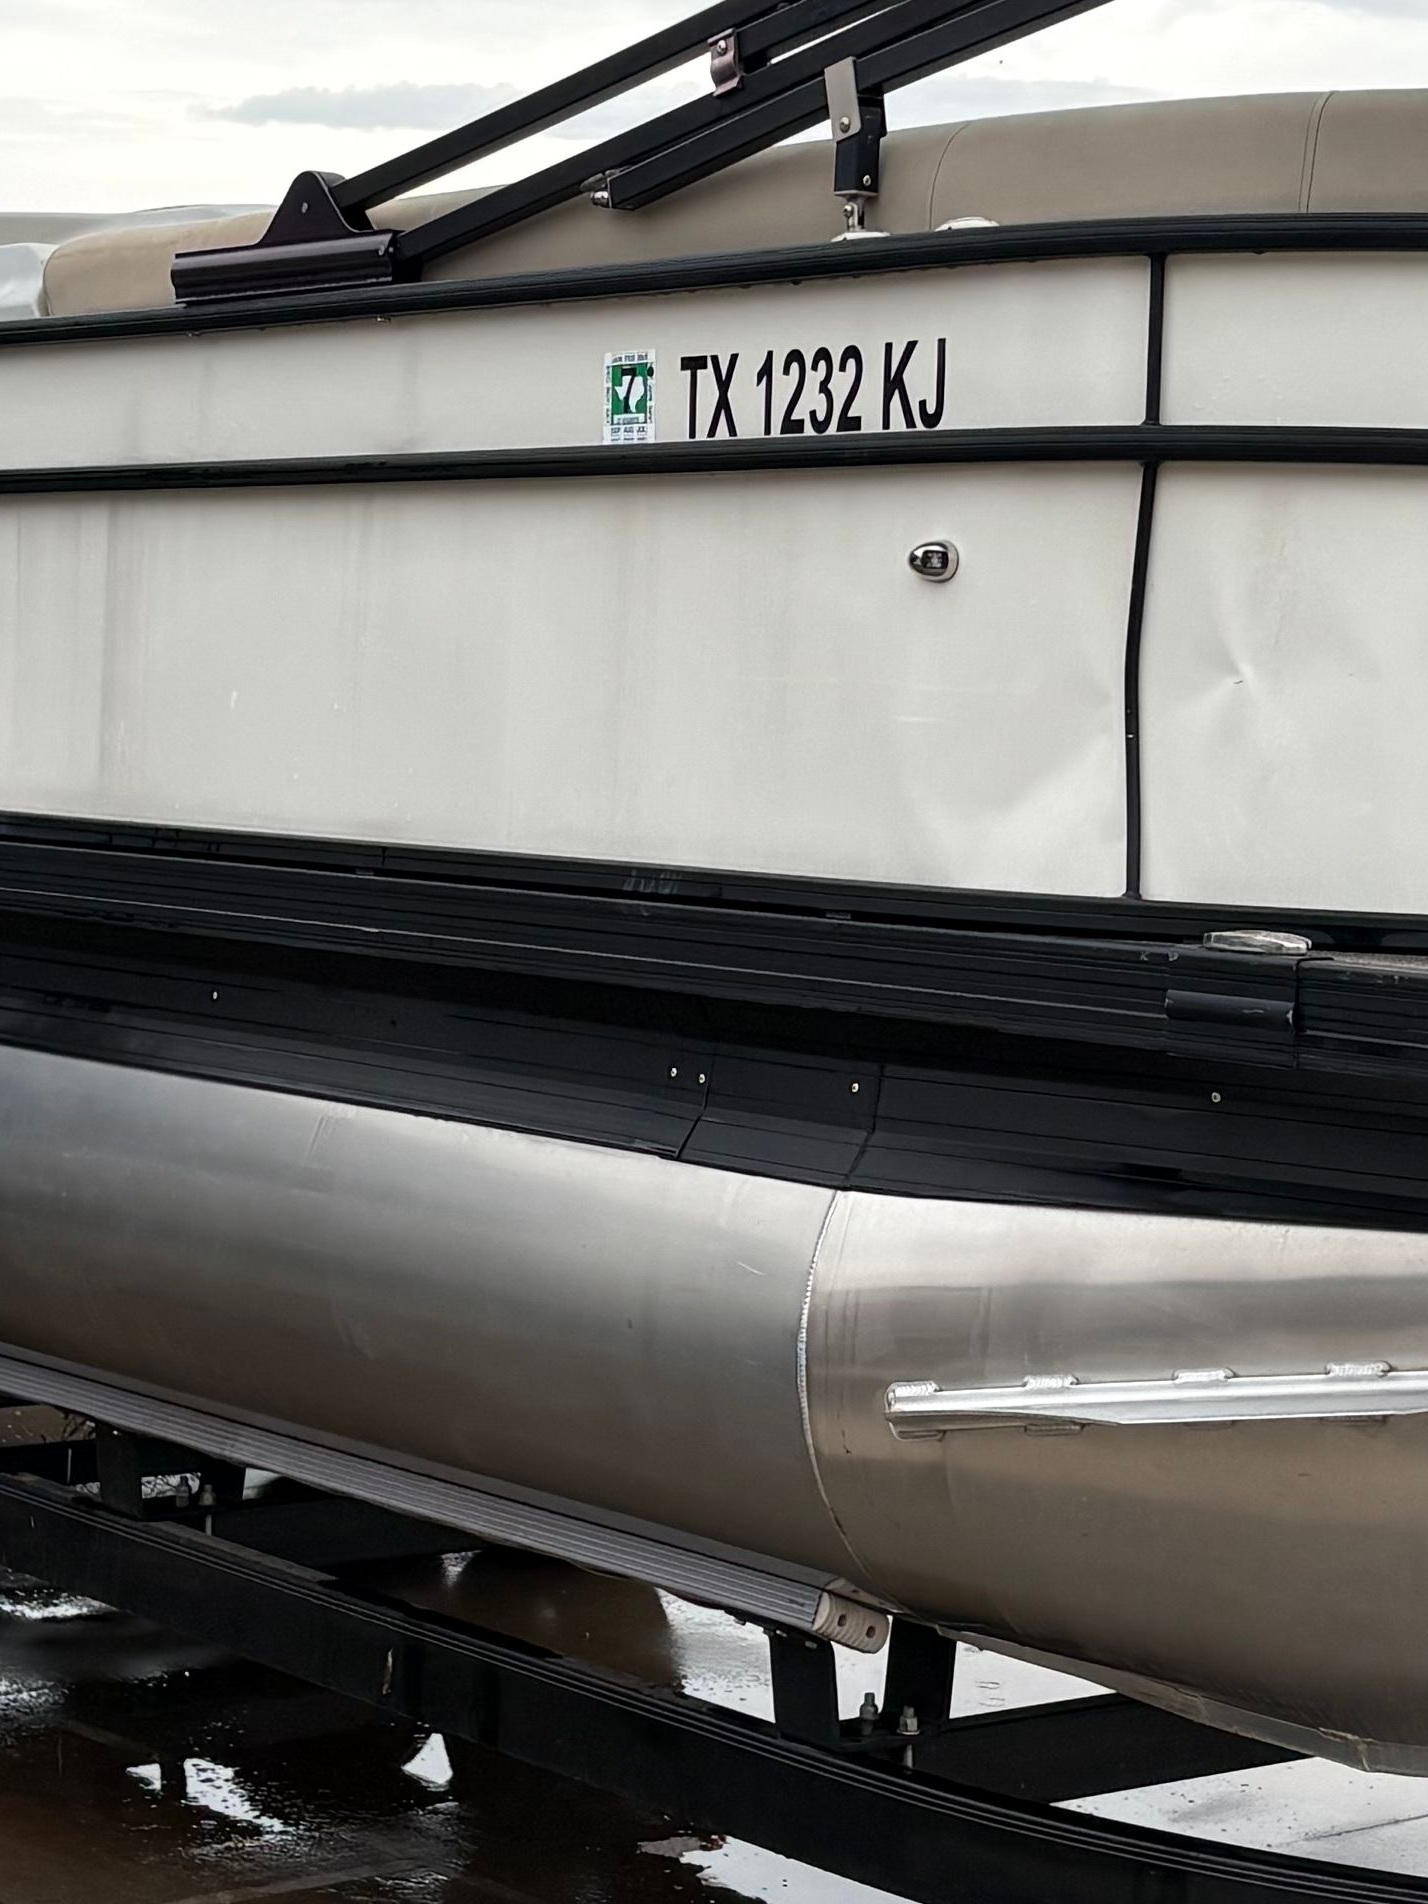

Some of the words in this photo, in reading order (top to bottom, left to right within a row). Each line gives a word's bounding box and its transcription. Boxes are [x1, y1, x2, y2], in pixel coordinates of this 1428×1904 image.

[679, 352, 740, 440] TX
[756, 344, 864, 437] 1232
[882, 337, 947, 431] KJ
